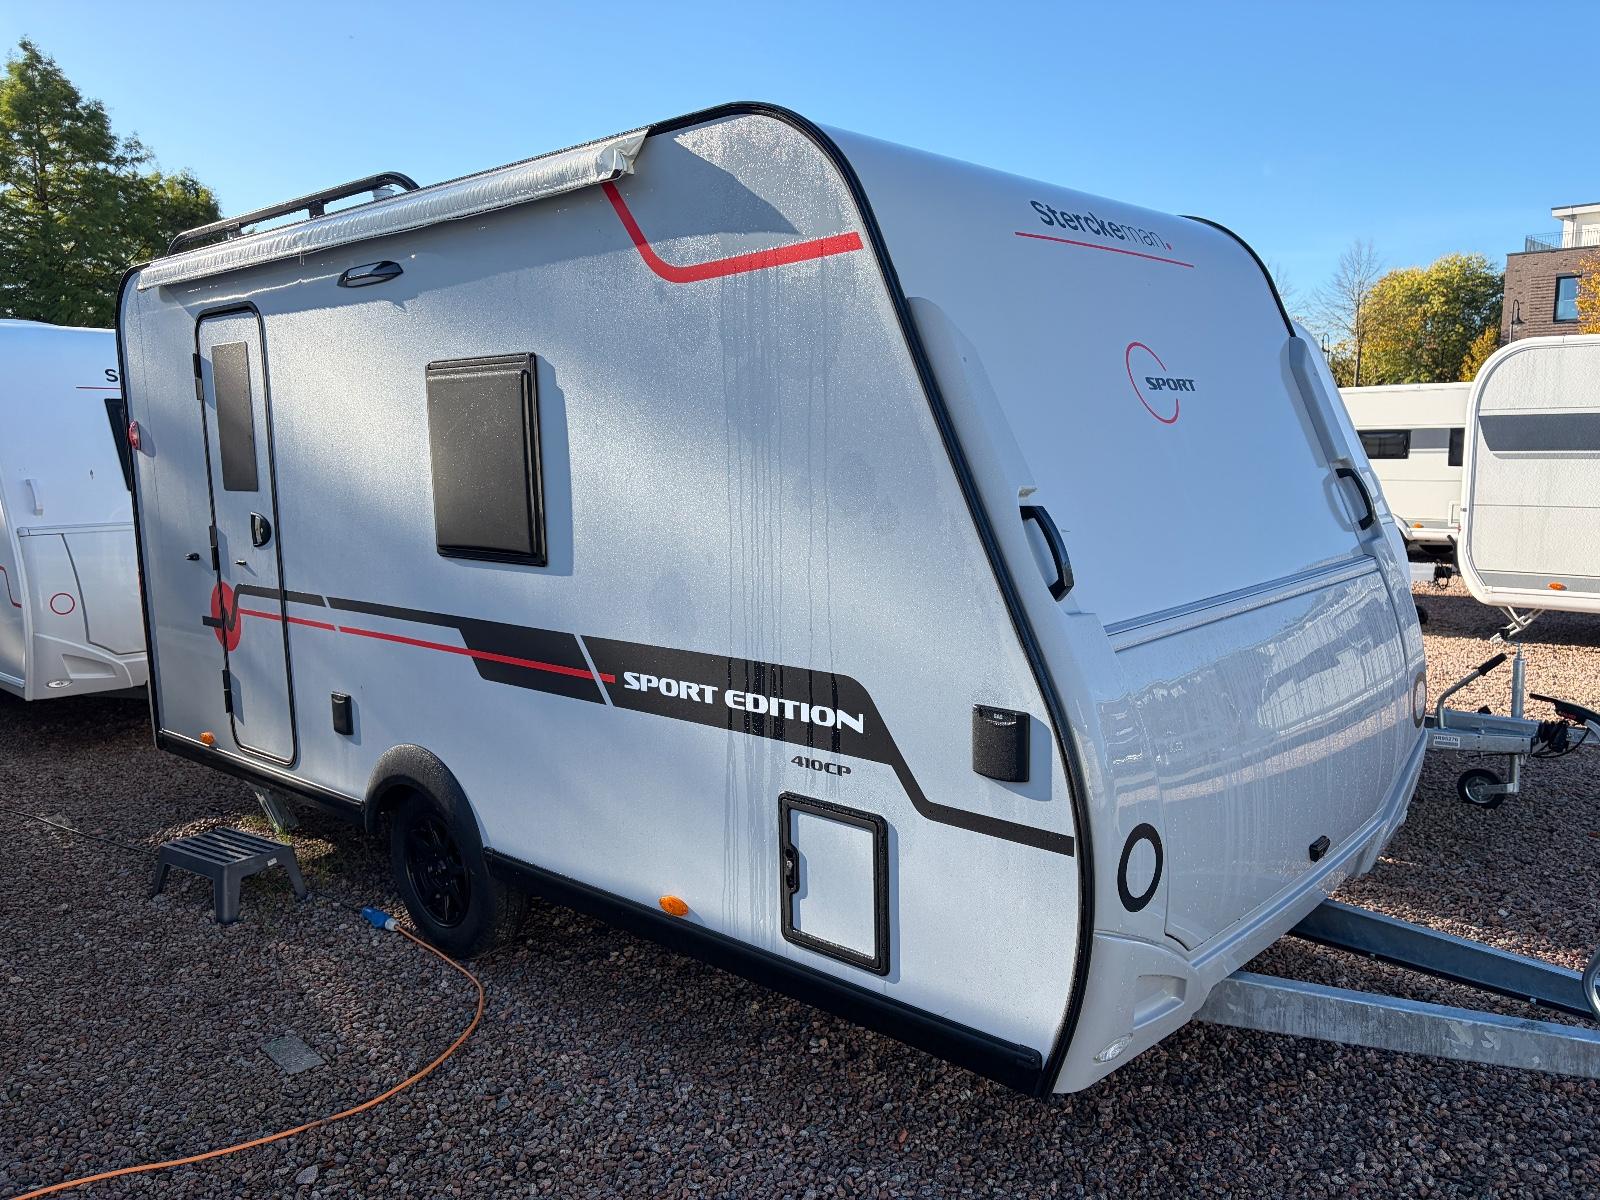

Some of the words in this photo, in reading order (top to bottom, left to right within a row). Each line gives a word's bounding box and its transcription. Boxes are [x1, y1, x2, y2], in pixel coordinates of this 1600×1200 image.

[1145, 376, 1196, 391] SPORT
[623, 671, 719, 704] SPORT
[724, 689, 864, 734] EDITION
[790, 755, 852, 777] 410CP
